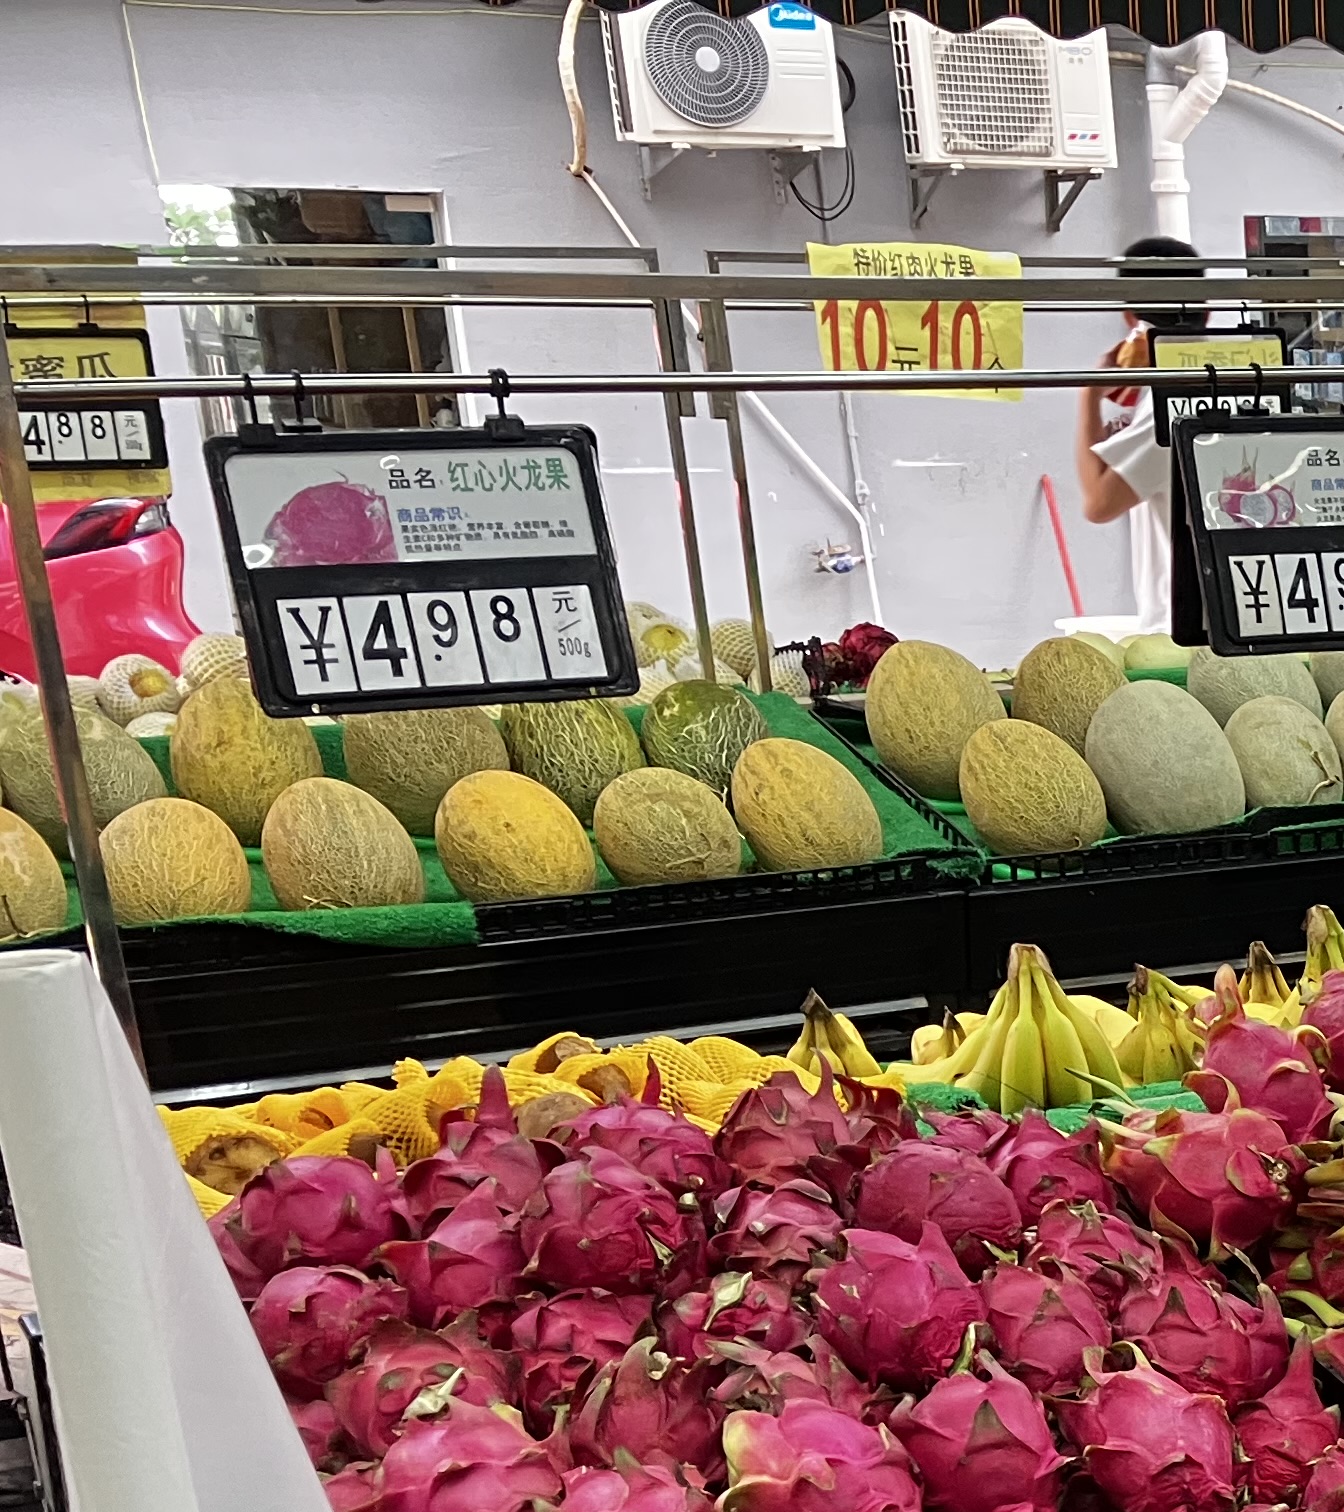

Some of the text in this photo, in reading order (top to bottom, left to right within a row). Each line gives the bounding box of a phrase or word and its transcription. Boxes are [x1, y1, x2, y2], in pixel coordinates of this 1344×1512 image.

[448, 456, 571, 493] 红心火龙果
[286, 595, 521, 682] ¥4.98
